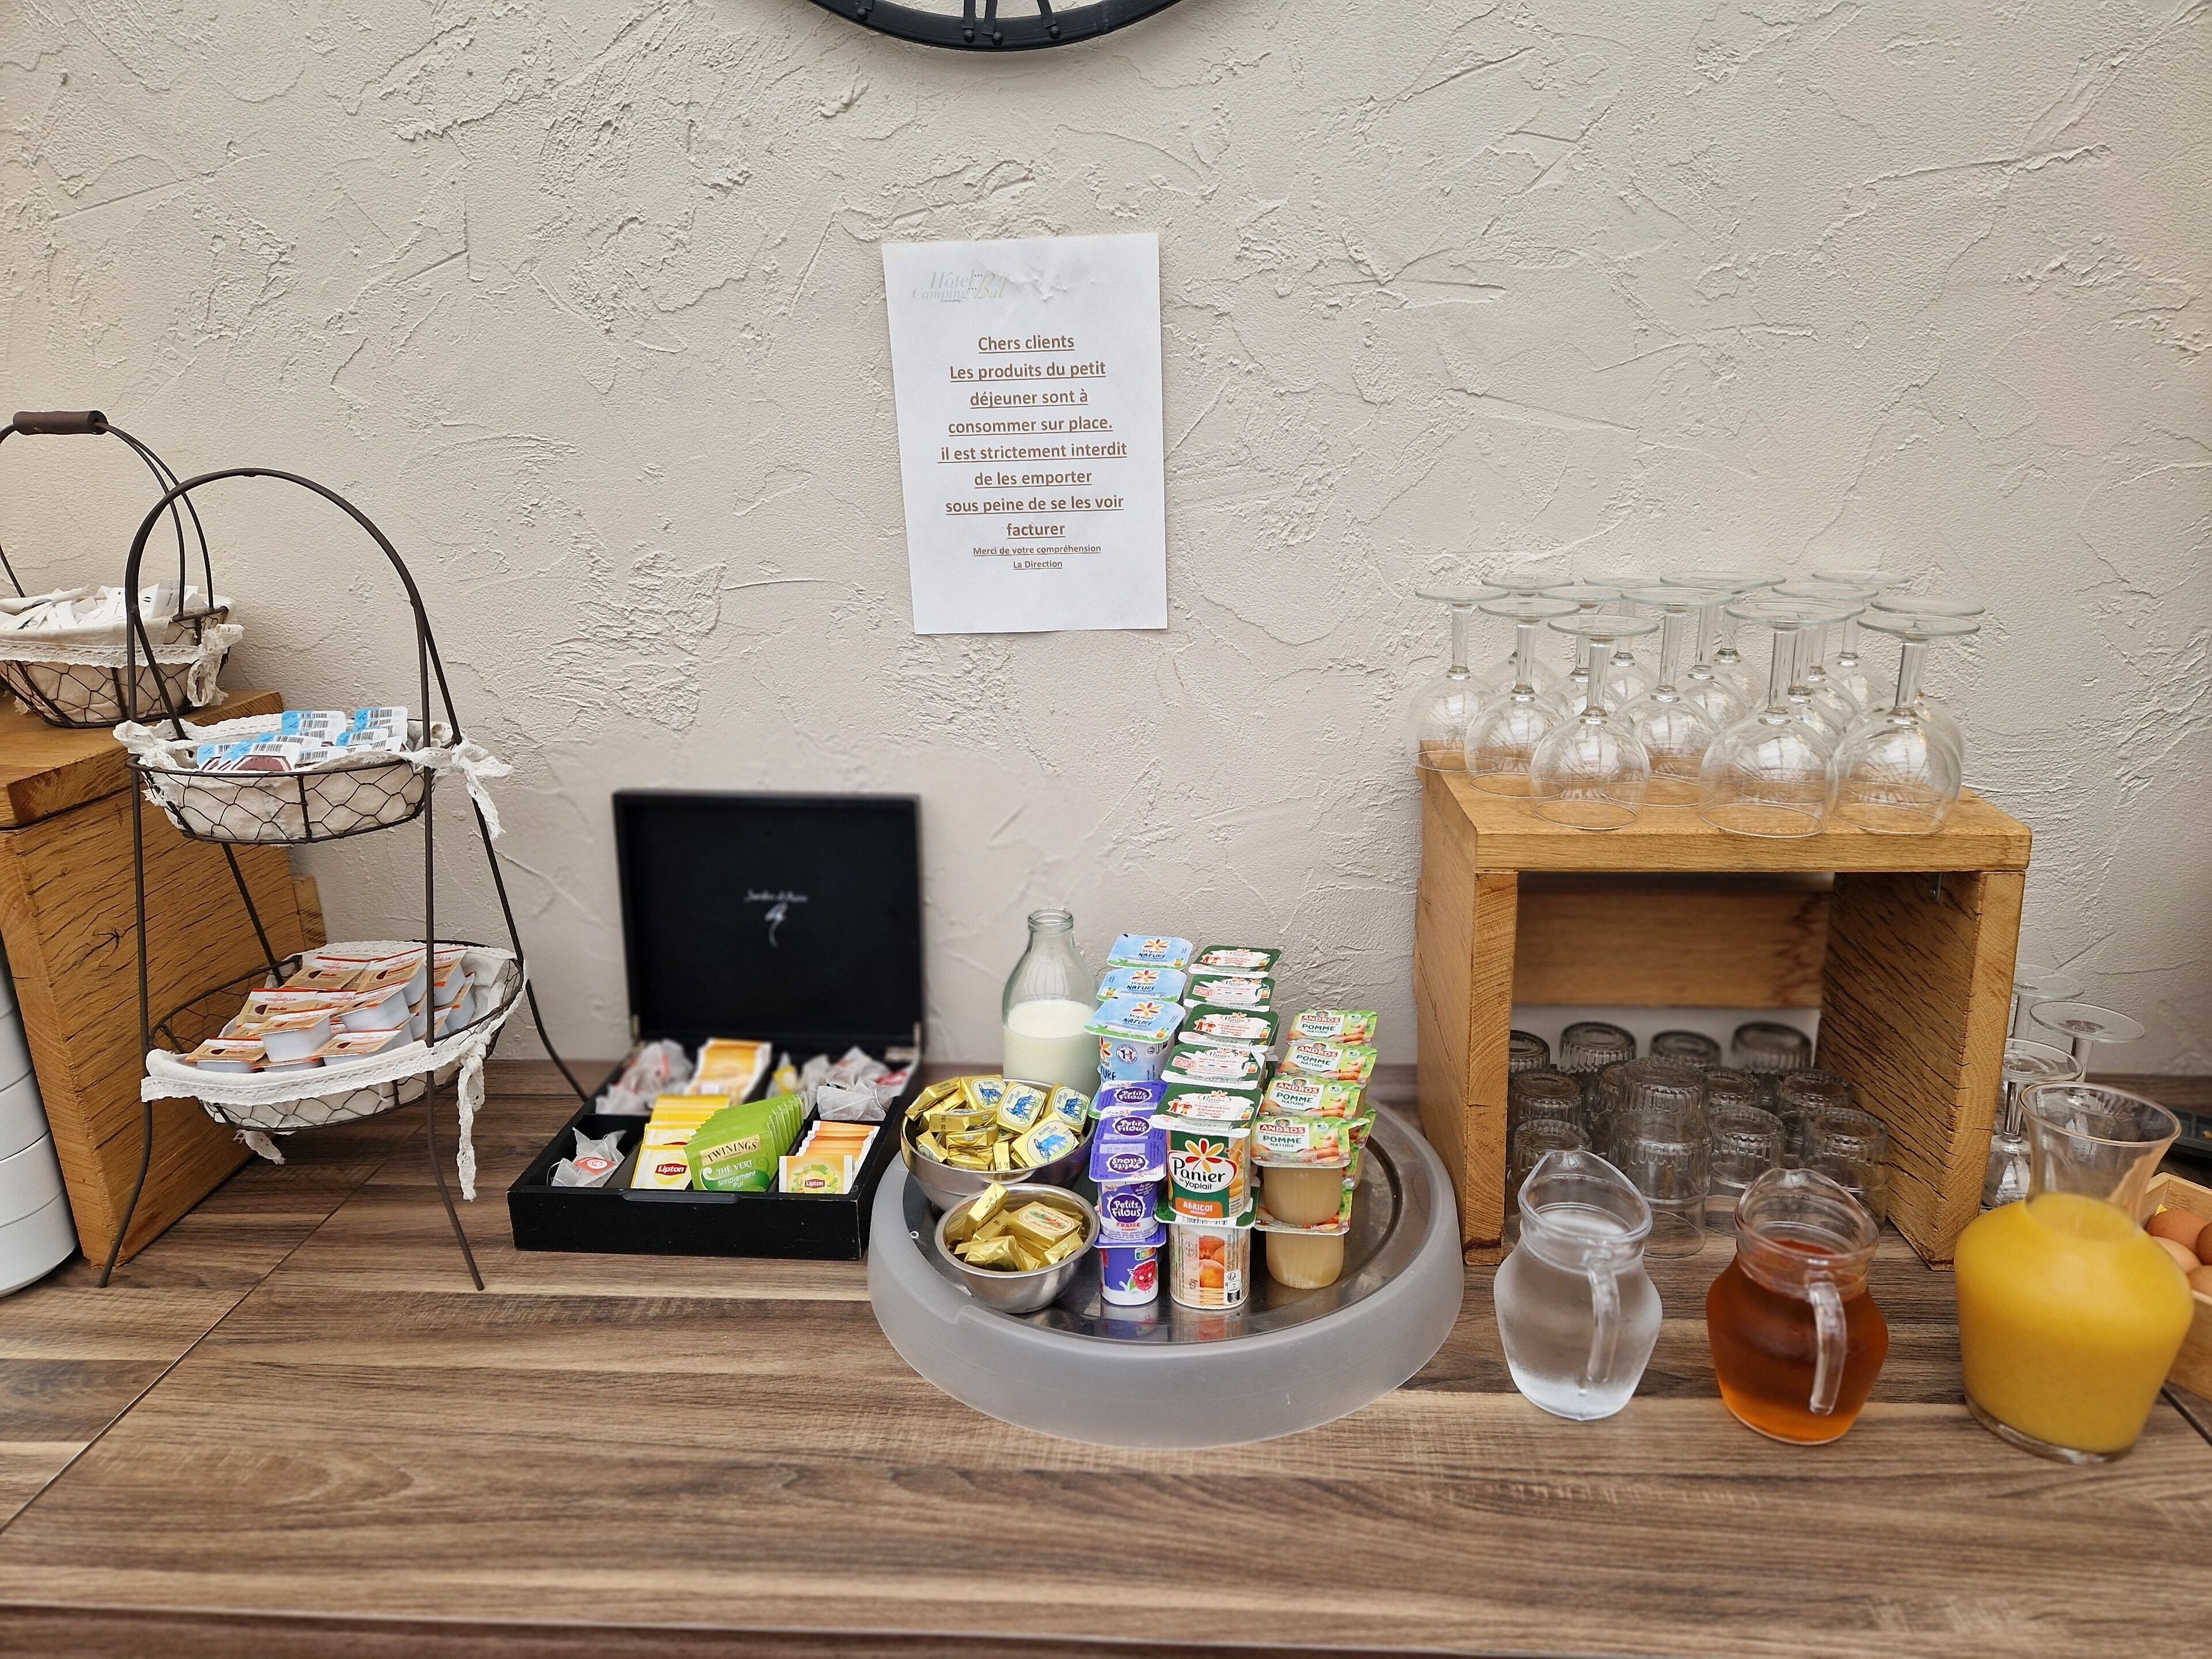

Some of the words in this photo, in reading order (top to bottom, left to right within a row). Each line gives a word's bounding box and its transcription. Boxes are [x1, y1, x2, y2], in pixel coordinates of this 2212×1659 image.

[931, 270, 975, 288] Hôtel
[913, 287, 968, 303] Camping
[978, 336, 1021, 351] Chers
[1025, 335, 1075, 350] clients
[950, 366, 974, 380] Les
[979, 363, 1042, 381] produits
[1046, 362, 1065, 376] du
[1070, 361, 1106, 378] petit
[970, 392, 1037, 408] déjeuner
[1042, 390, 1075, 403] sont
[1080, 388, 1088, 402] à
[948, 421, 1037, 433] consommer
[1041, 418, 1065, 431] sur
[1069, 416, 1113, 432] place.
[941, 447, 949, 460] il
[954, 448, 976, 460] est
[980, 445, 1067, 459] strictement
[1071, 442, 1127, 456] interdit
[974, 472, 993, 486] de
[997, 471, 1017, 485] les
[1021, 471, 1092, 486] emporter
[945, 501, 979, 512] sous
[983, 498, 1024, 513] peine
[1028, 497, 1047, 510] de
[1051, 498, 1066, 510] se
[1071, 495, 1091, 509] les
[1095, 495, 1124, 508] voir
[1006, 523, 1066, 537] facturer
[973, 547, 997, 555] Merci
[999, 547, 1010, 555] de
[1012, 546, 1035, 554] votre
[1036, 544, 1101, 555] compréhension
[1024, 560, 1063, 569] Direction
[1123, 1017, 1153, 1026] NATURE
[1298, 1046, 1338, 1058] ANDROS
[1296, 1054, 1332, 1065] POMME
[1277, 1082, 1319, 1093] ANDROS
[1277, 1092, 1313, 1103] POMME
[1261, 1124, 1305, 1133] ANDROS
[1263, 1135, 1302, 1144] POMME
[706, 1141, 757, 1162] TWININGS
[658, 1165, 684, 1175] Lipton
[717, 1164, 732, 1175] THÉ
[734, 1160, 753, 1170] VERT
[1172, 1157, 1225, 1183] Panier
[718, 1171, 756, 1187] Simplement
[1113, 1200, 1139, 1209] Petits
[1183, 1201, 1213, 1212] ABRICOT
[1111, 1208, 1141, 1217] Filous
